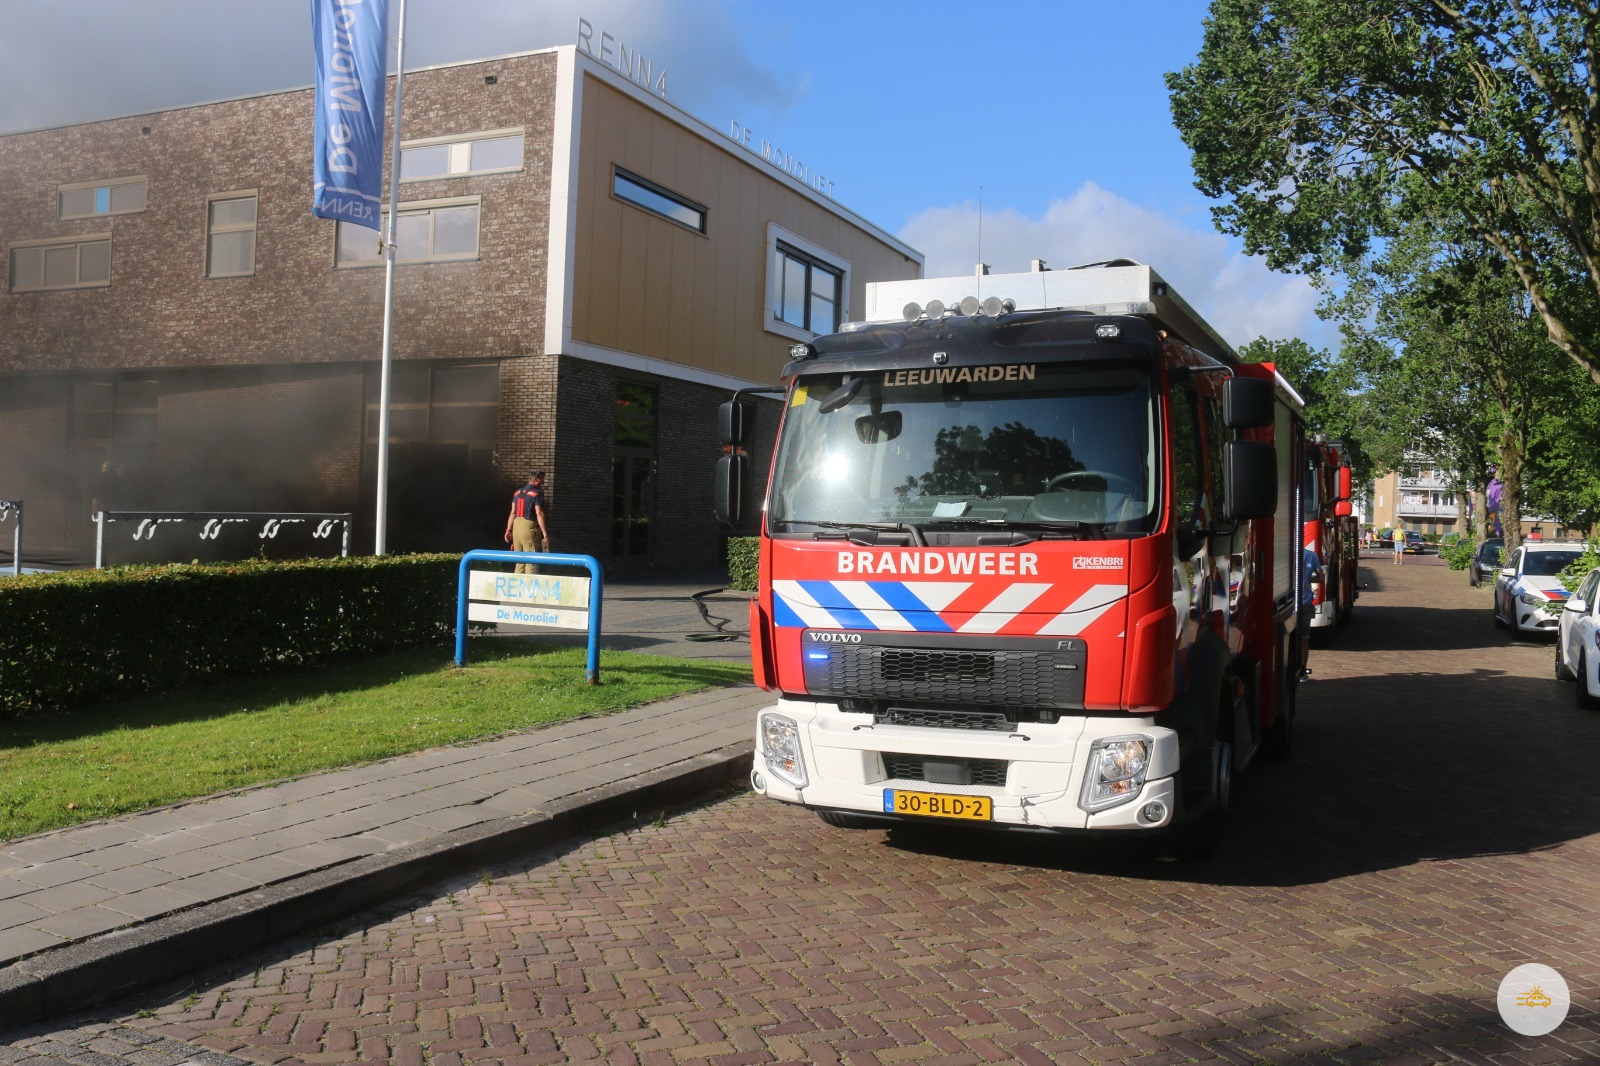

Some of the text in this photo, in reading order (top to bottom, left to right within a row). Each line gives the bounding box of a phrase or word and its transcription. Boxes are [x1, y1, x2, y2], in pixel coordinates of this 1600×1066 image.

[577, 16, 667, 97] RENN4
[731, 119, 835, 199] DE MONOLIET
[883, 364, 1036, 387] LEEUWARDEN
[837, 552, 1039, 576] BRANDWEER
[1085, 556, 1124, 566] KENBRI
[495, 576, 561, 600] RENN4
[496, 609, 559, 623] De Monoliet
[808, 632, 862, 643] VOLVO
[1057, 640, 1078, 650] FL
[898, 794, 983, 817] 30-BLD-2
